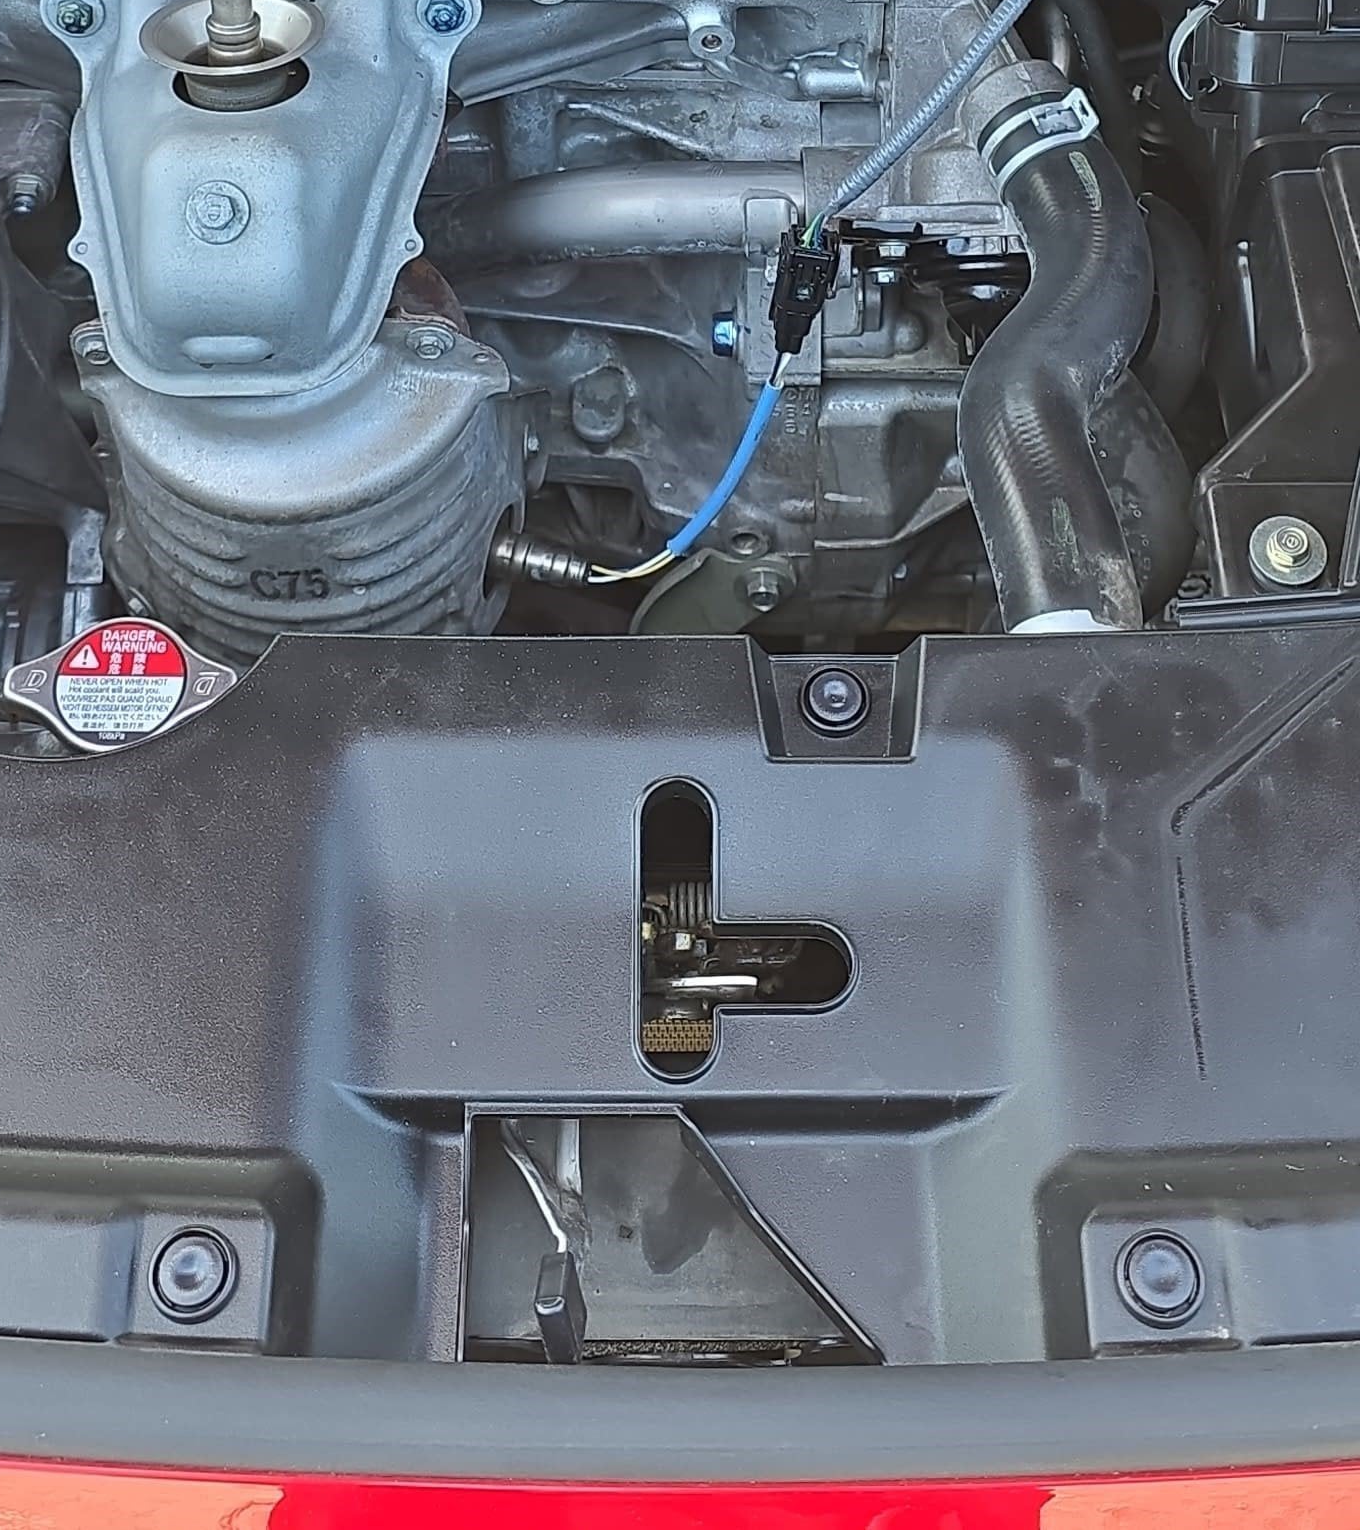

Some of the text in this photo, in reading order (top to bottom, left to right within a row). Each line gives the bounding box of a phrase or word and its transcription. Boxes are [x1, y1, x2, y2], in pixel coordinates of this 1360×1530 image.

[103, 629, 157, 641] DANGER
[101, 641, 167, 653] WARNUNG
[150, 678, 168, 686] HOT
[83, 686, 110, 694] coolant
[100, 695, 115, 703] PAS
[117, 695, 145, 703] QUAND
[145, 695, 173, 704] CHAUD
